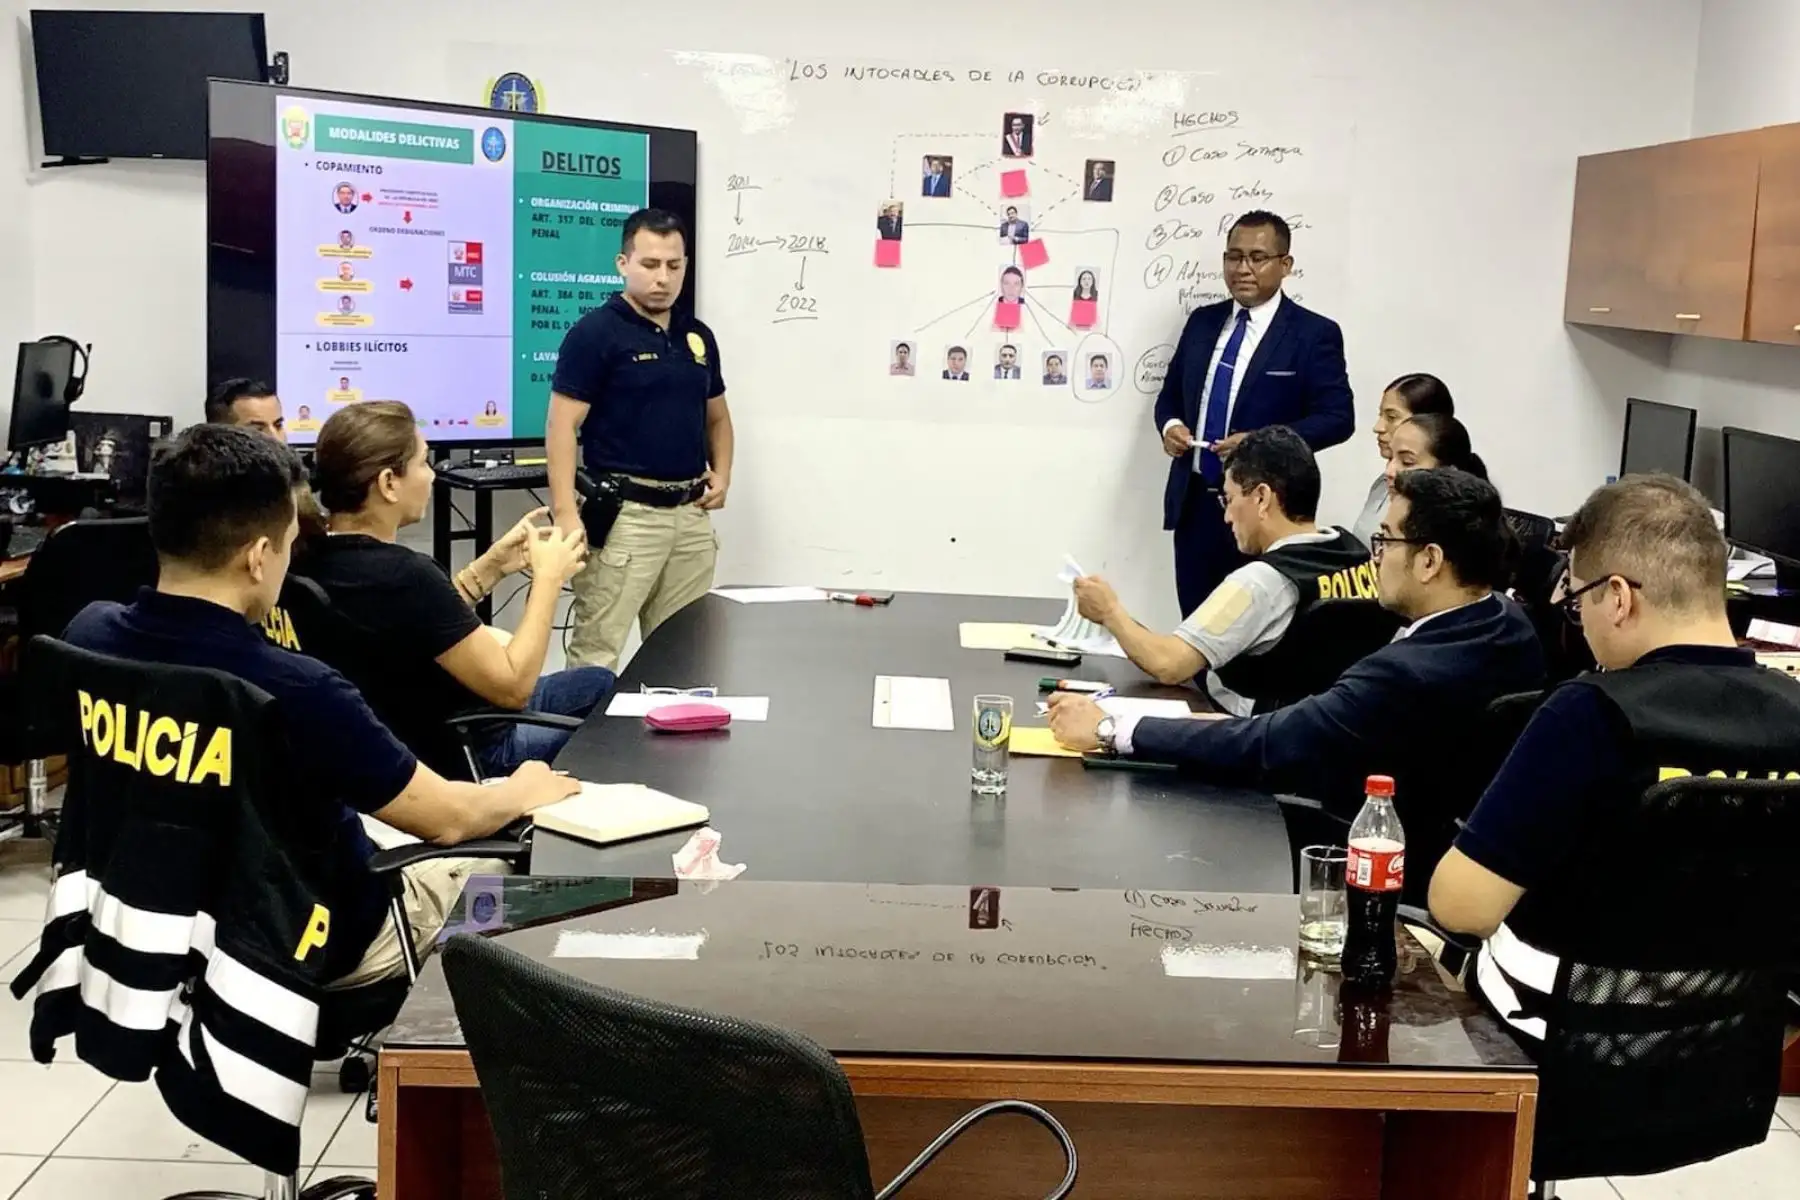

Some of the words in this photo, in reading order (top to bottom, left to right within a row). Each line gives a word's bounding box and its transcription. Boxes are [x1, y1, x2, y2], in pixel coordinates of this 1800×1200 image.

[968, 70, 993, 81] DE
[1173, 110, 1239, 129] HECHOS
[328, 127, 397, 144] MODALIDES
[399, 132, 460, 149] DELICTIVAS
[1189, 147, 1228, 162] Caso
[316, 161, 383, 175] COPAMIENTO
[542, 150, 621, 176] DELITOS
[1178, 186, 1214, 206] Caso
[530, 197, 598, 211] ORGANIZACIÓN
[579, 216, 595, 226] DEL
[532, 228, 560, 239] PENAL
[454, 265, 477, 279] MTC
[531, 270, 576, 284] COLUSIÓN
[577, 274, 625, 285] AGRAVADA
[578, 290, 594, 300] DEL
[531, 304, 560, 315] PENAL
[776, 294, 818, 312] 2022
[531, 320, 550, 330] POR
[552, 321, 561, 330] EL
[316, 342, 361, 352] LOBBIES
[364, 340, 408, 353] ILÍCITOS
